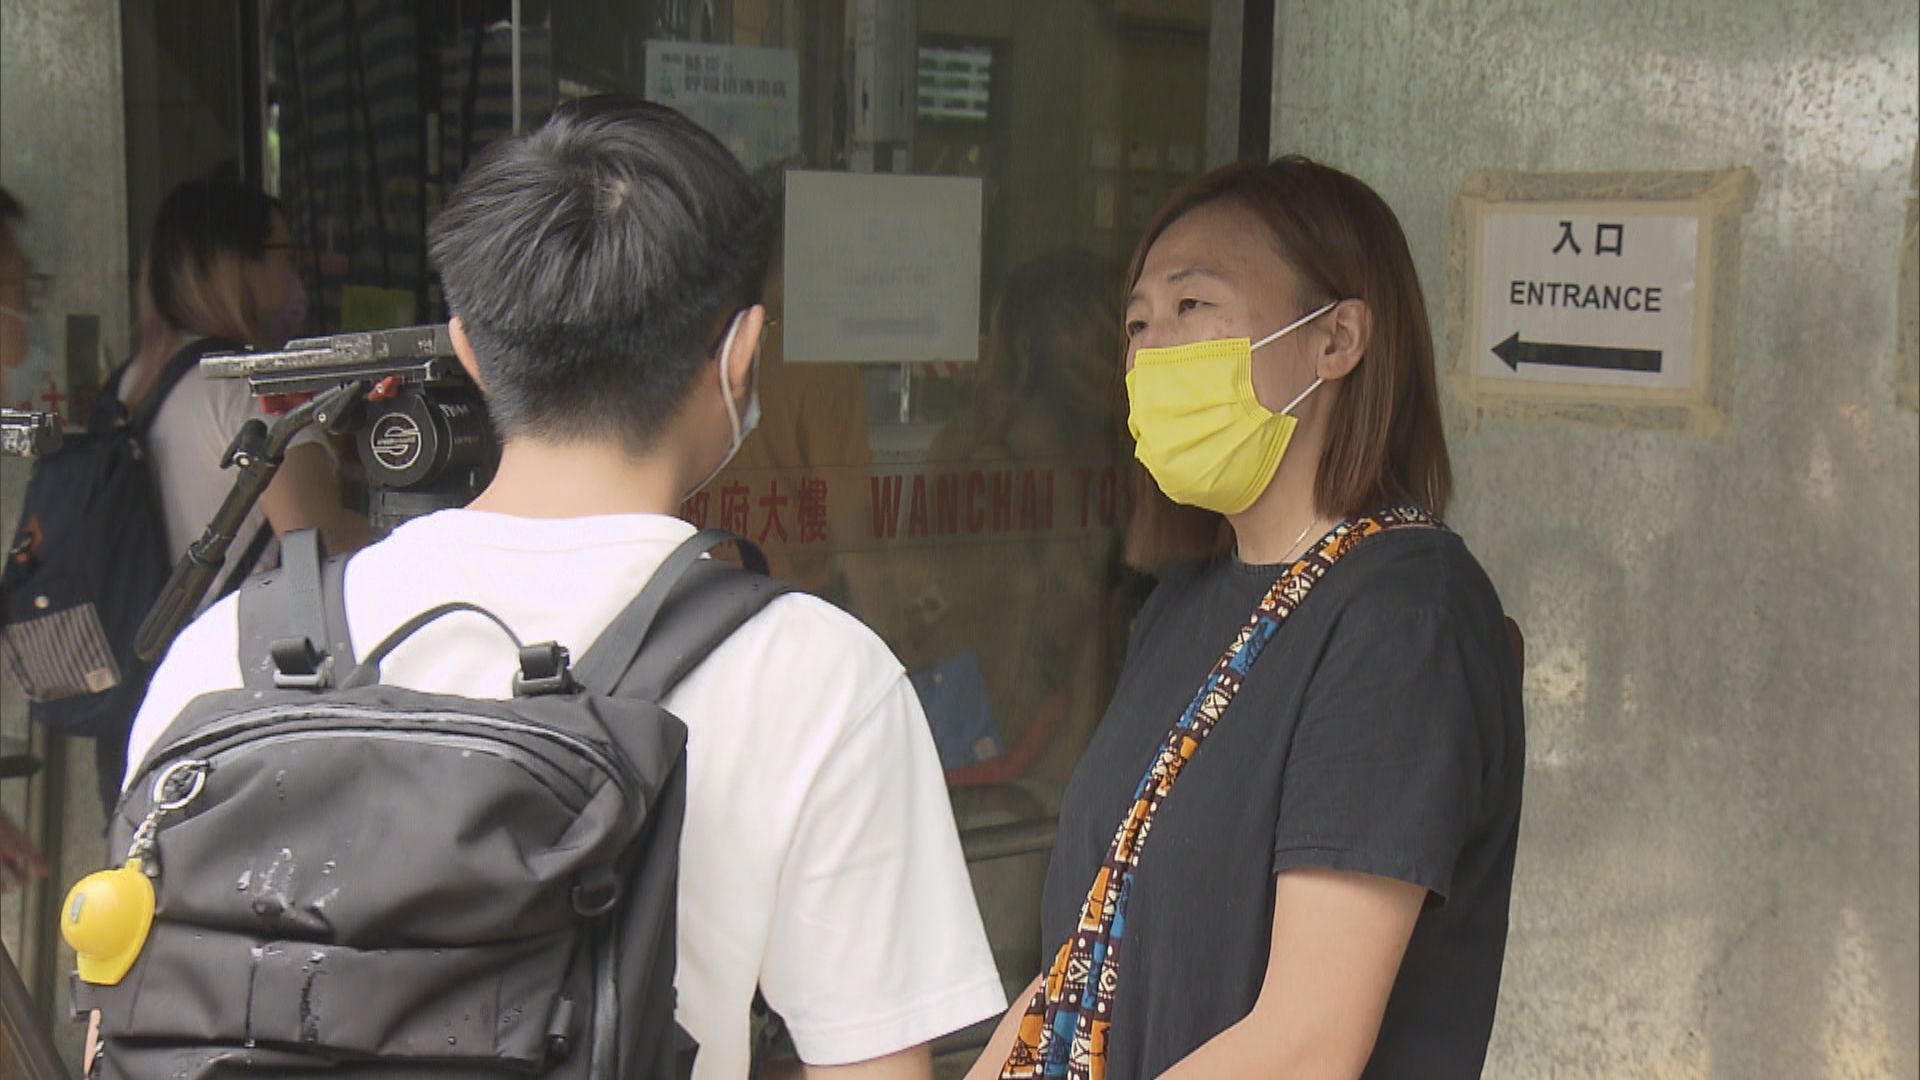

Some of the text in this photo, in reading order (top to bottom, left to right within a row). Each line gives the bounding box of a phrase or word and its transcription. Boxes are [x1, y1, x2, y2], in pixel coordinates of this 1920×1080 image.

[1552, 220, 1624, 257] 入口
[1510, 280, 1662, 312] ENTRANCE
[870, 468, 1055, 539] WANCHAI
[1073, 466, 1137, 529] TO
